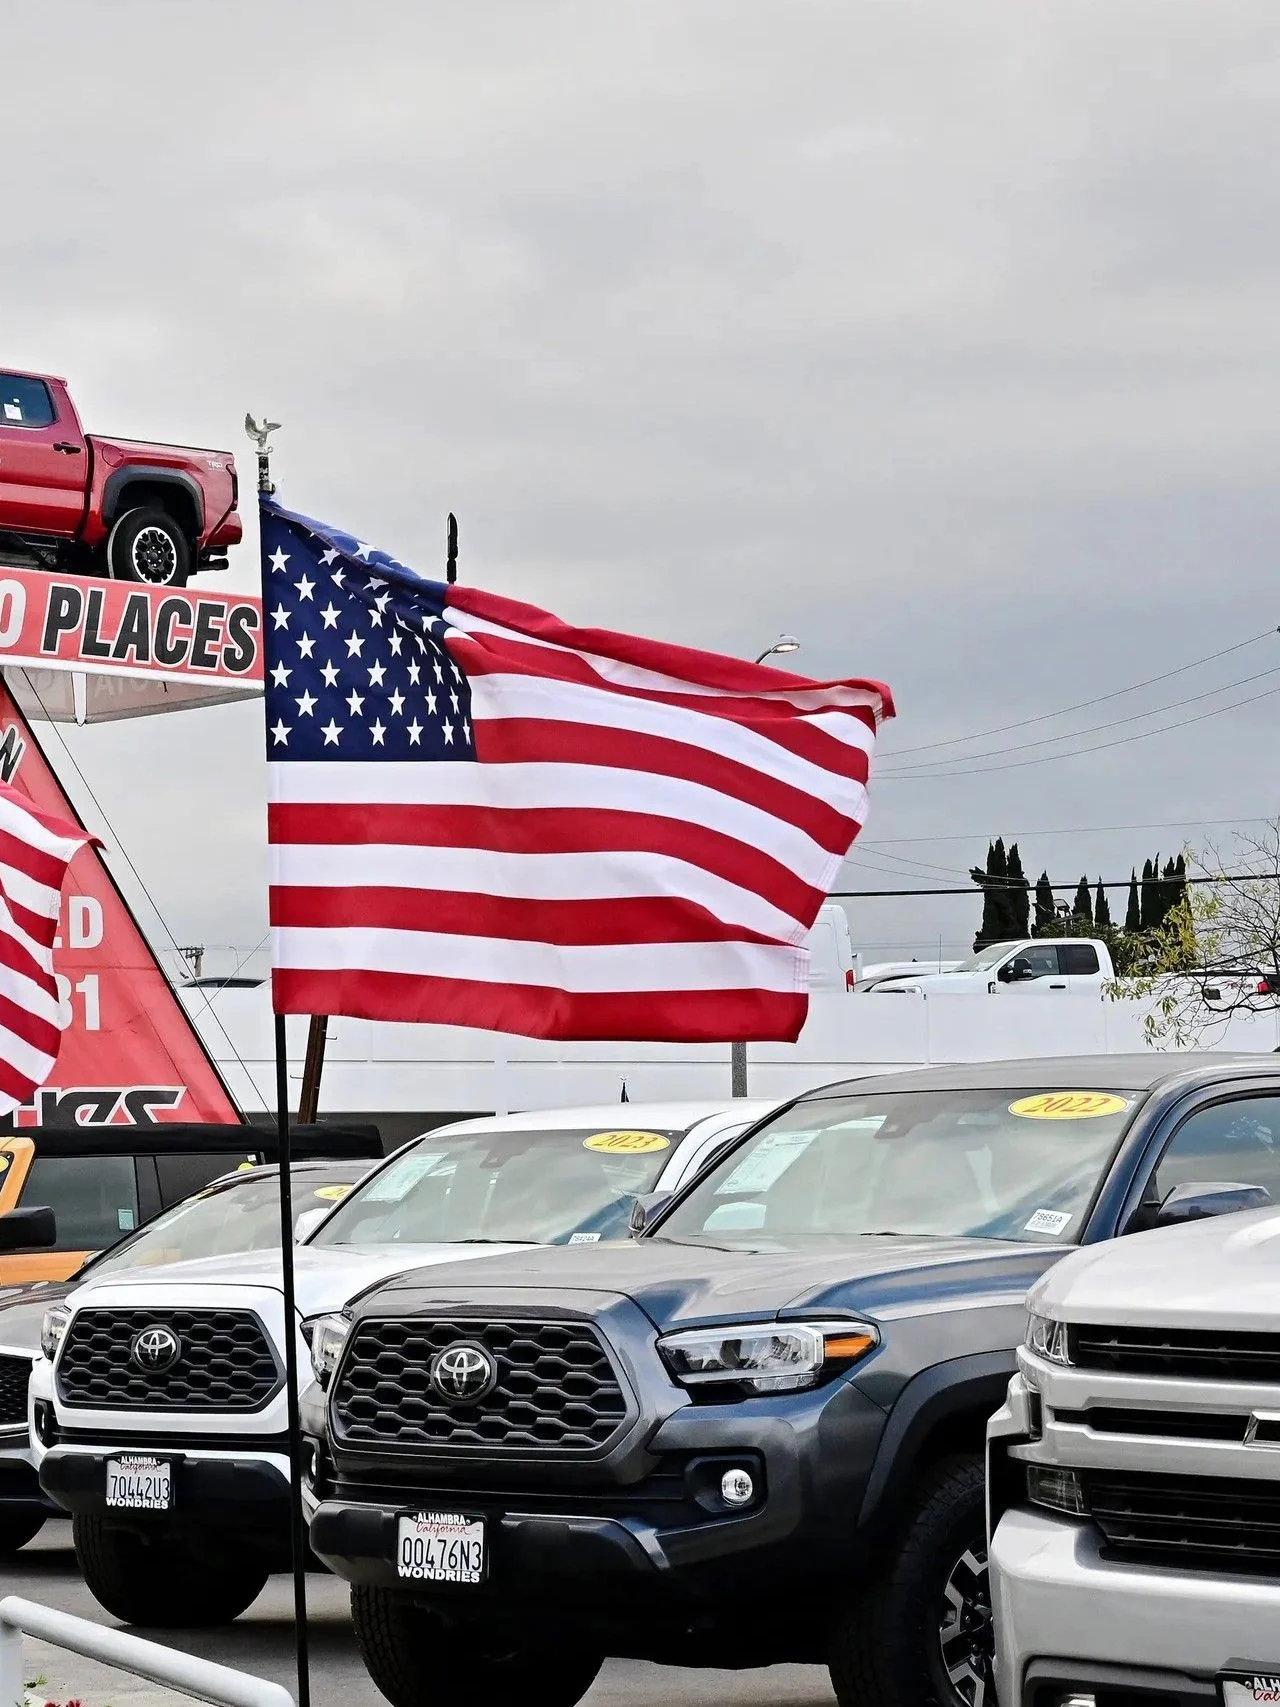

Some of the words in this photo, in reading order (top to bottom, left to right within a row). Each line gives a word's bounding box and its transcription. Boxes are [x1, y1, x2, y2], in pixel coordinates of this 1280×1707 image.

[40, 582, 261, 676] PLACES
[1022, 1096, 1112, 1113] 2022
[592, 1134, 658, 1149] 2023
[121, 1456, 157, 1465] ALHAMBRA
[111, 1475, 170, 1500] 70442U3
[106, 1497, 169, 1509] WONDRIES
[417, 1512, 466, 1526] ALHAMBRA
[416, 1522, 471, 1538] California
[402, 1537, 482, 1571] 00476N3
[398, 1566, 480, 1583] WONDRIES
